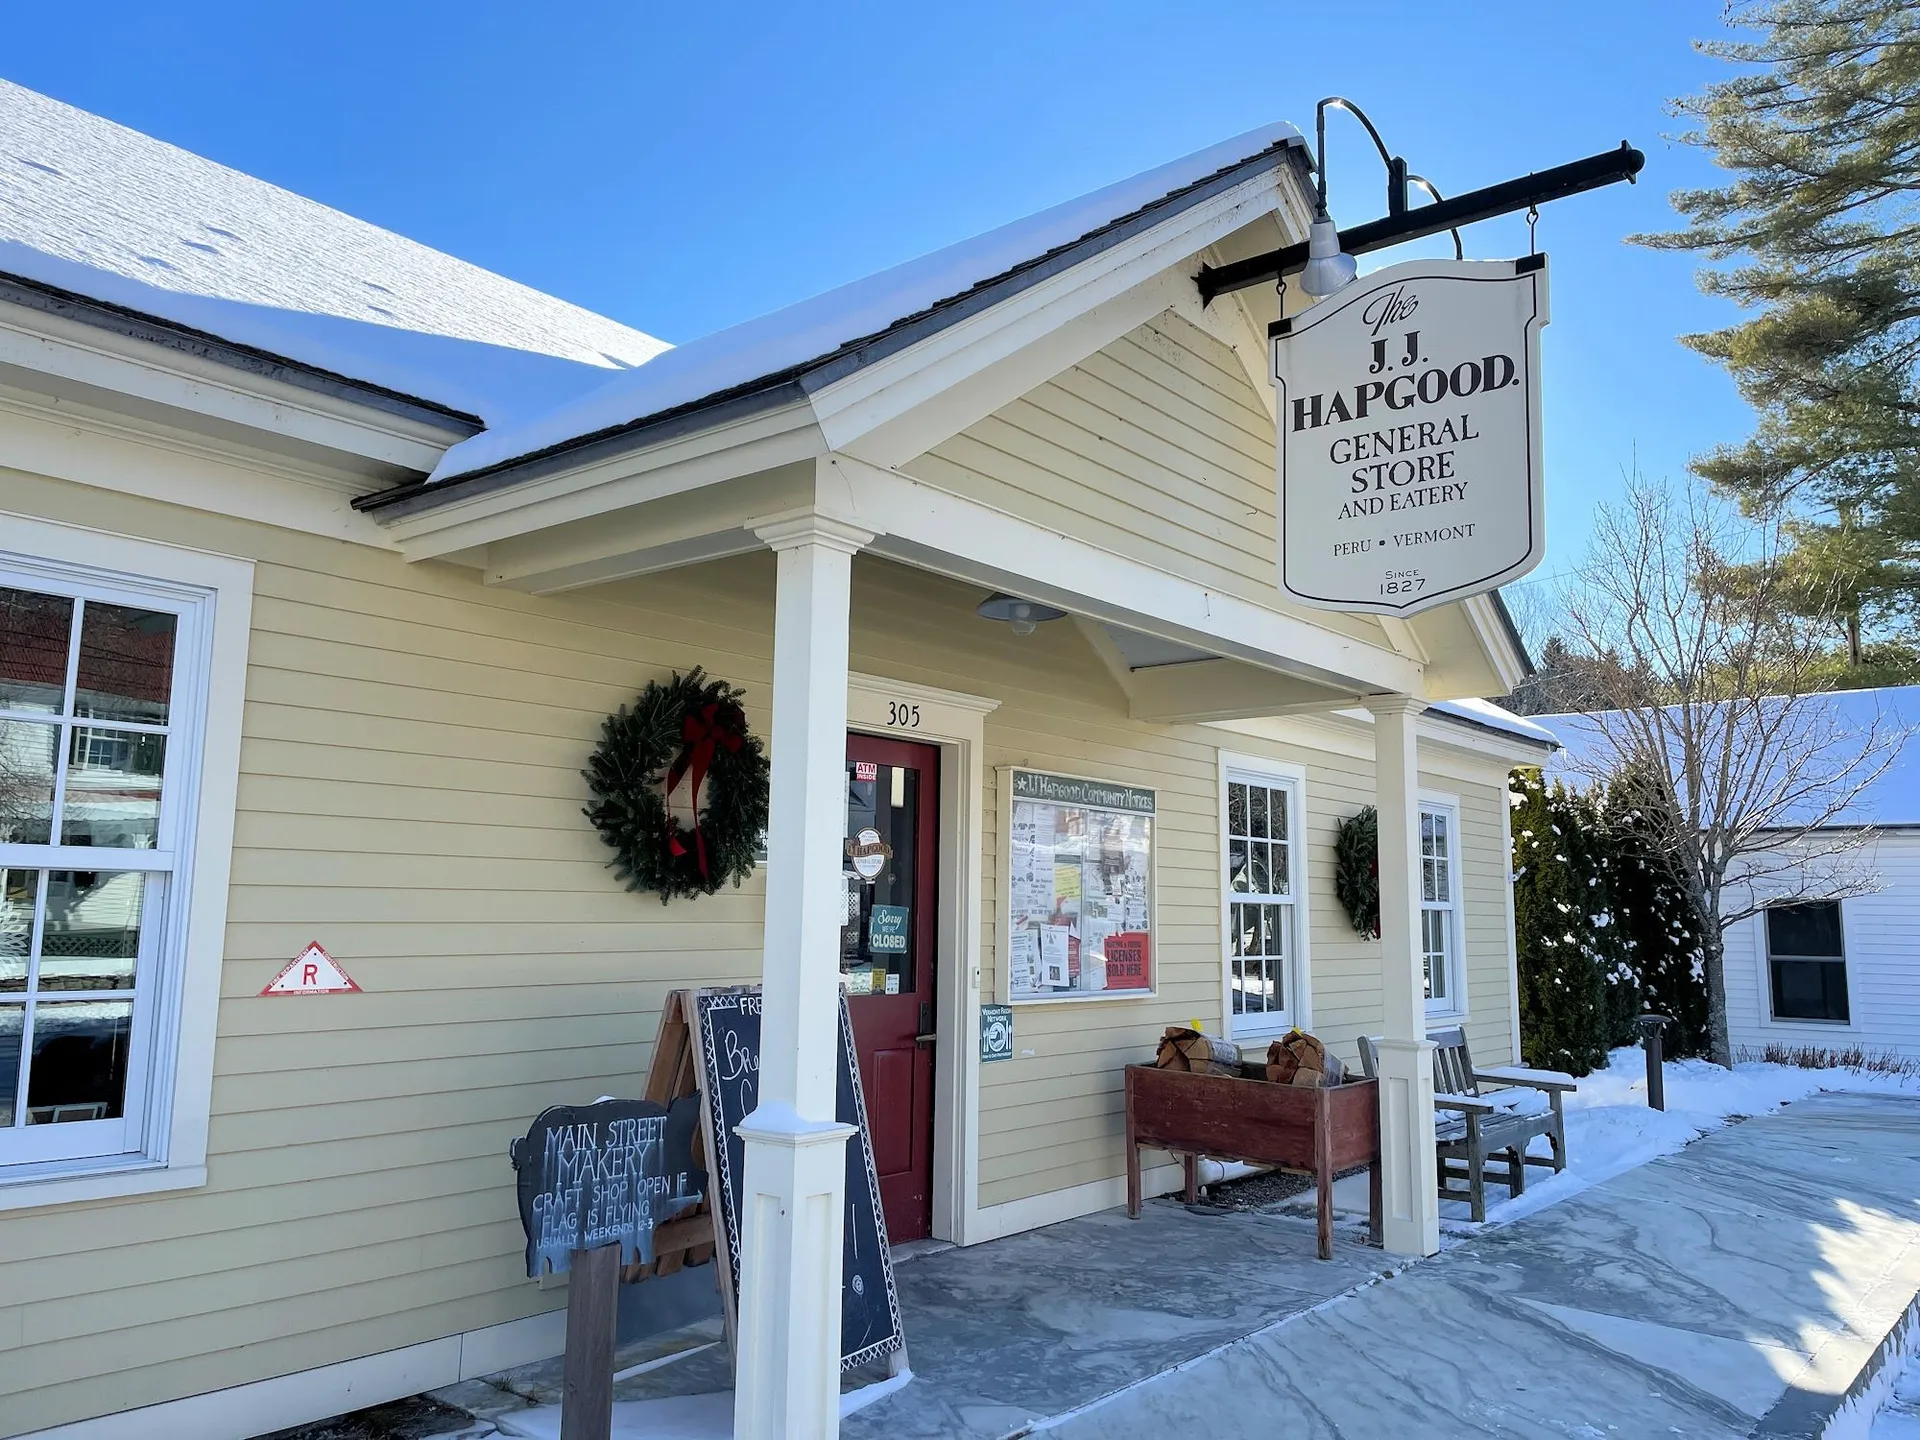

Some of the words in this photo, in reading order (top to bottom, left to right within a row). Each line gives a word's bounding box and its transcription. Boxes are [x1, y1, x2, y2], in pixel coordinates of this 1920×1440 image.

[1362, 285, 1419, 336] The
[1291, 354, 1520, 432] HAPGOOD.
[1330, 414, 1480, 465] GENERAL
[1351, 450, 1455, 494] STORE
[1338, 496, 1384, 520] AND
[1390, 482, 1469, 512] EATERY
[1334, 539, 1372, 557] PERU
[1393, 523, 1476, 548] VERMONT
[1379, 579, 1426, 595] 1827
[887, 702, 920, 727] 305
[857, 763, 876, 774] ATM
[857, 773, 876, 781] INSIDE
[878, 909, 902, 929] Sorry
[872, 934, 906, 949] CLOSED
[1107, 949, 1142, 962] LICENSES
[303, 964, 318, 985] R
[1107, 963, 1124, 977] SOLD
[1126, 963, 1142, 976] HERE
[544, 1122, 598, 1155] MAIN
[605, 1116, 667, 1147] STREET
[557, 1143, 650, 1185] MAKERY
[533, 1188, 583, 1212] CRAFT
[592, 1181, 629, 1203] SHOP
[637, 1175, 671, 1196] OPEN
[676, 1172, 688, 1193] IF
[542, 1212, 577, 1234] FLAG
[587, 1208, 598, 1226] IS
[605, 1200, 650, 1222] FLYING
[536, 1233, 578, 1249] USUALLY
[584, 1222, 634, 1242] WEEKENDS
